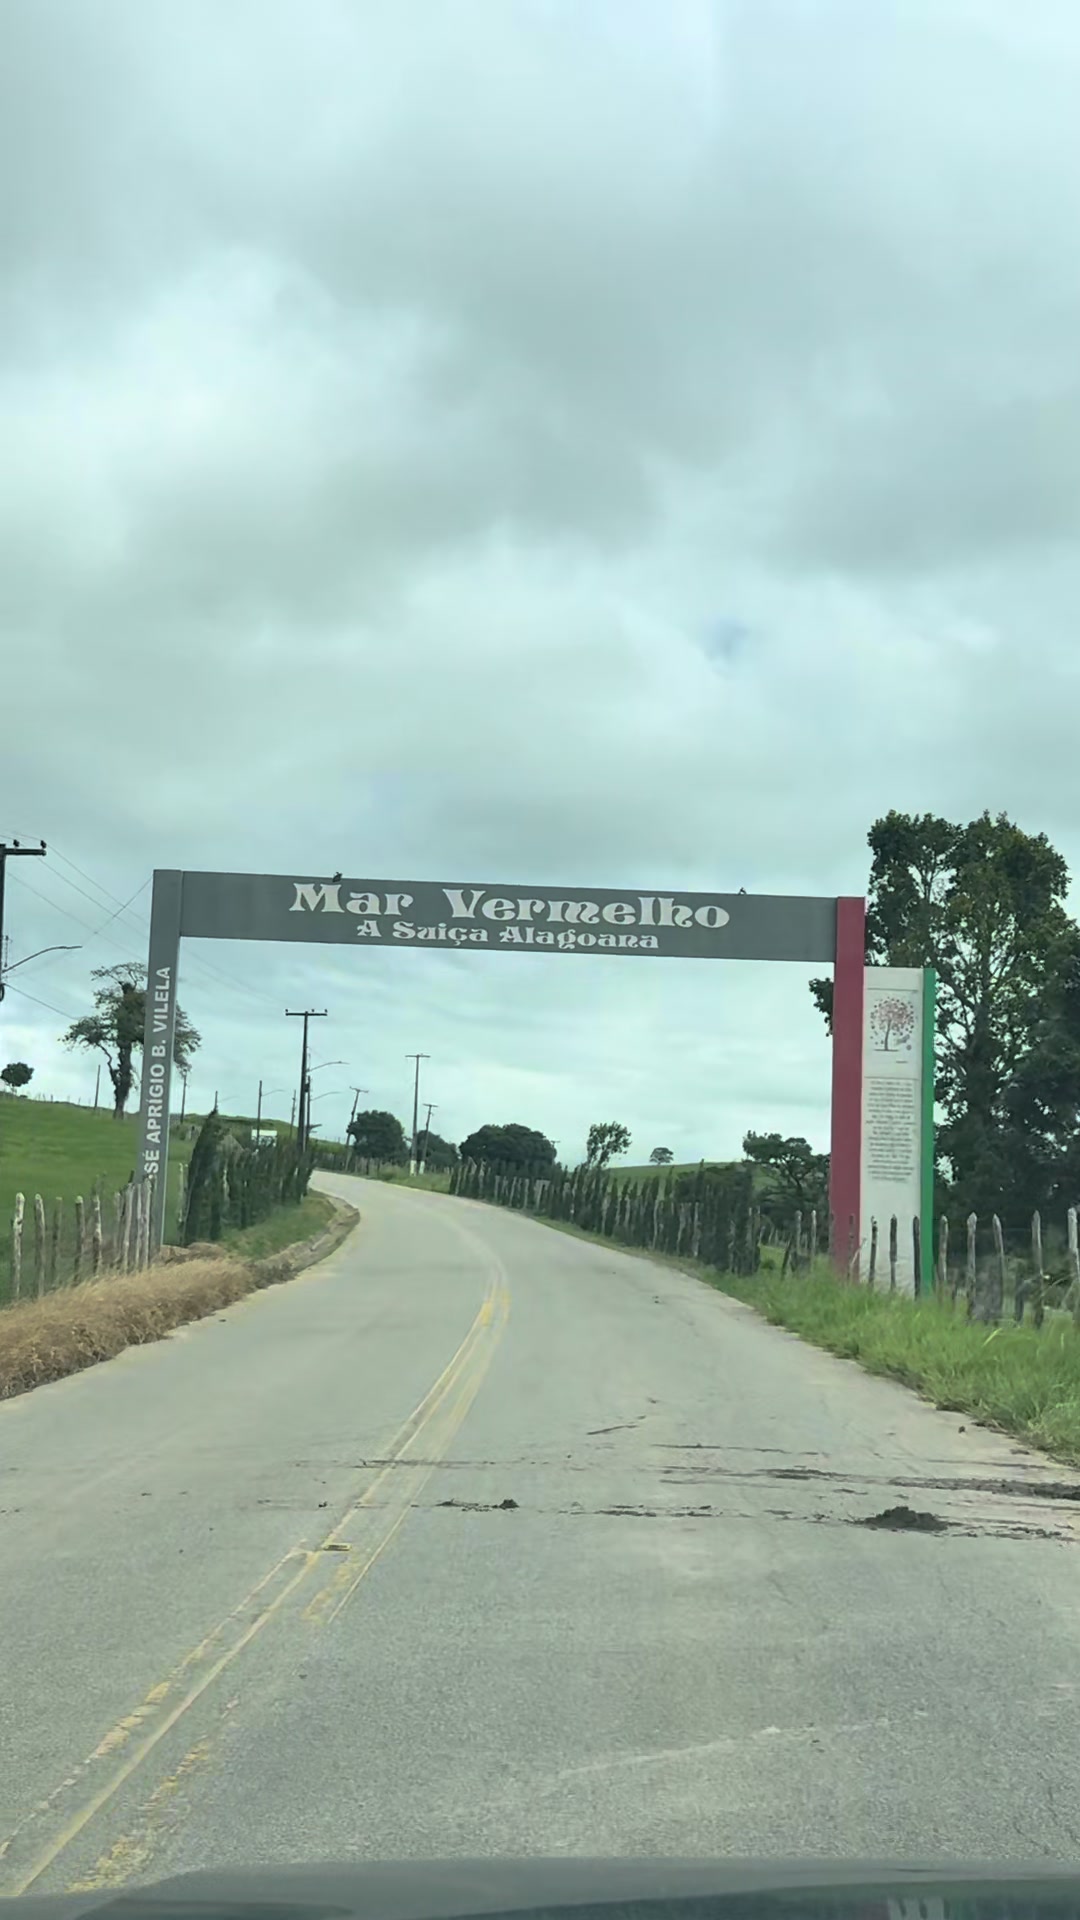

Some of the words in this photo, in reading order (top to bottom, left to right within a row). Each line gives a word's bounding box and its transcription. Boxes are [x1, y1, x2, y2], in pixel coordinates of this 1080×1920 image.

[288, 882, 414, 916] Mar
[442, 888, 730, 929] Vermelho
[356, 919, 382, 938] A
[392, 921, 489, 946] Suiça
[498, 925, 659, 949] Alagoana
[151, 966, 171, 1033] VILELA
[151, 1039, 167, 1058] B.
[144, 1063, 165, 1144] APRÍGIO
